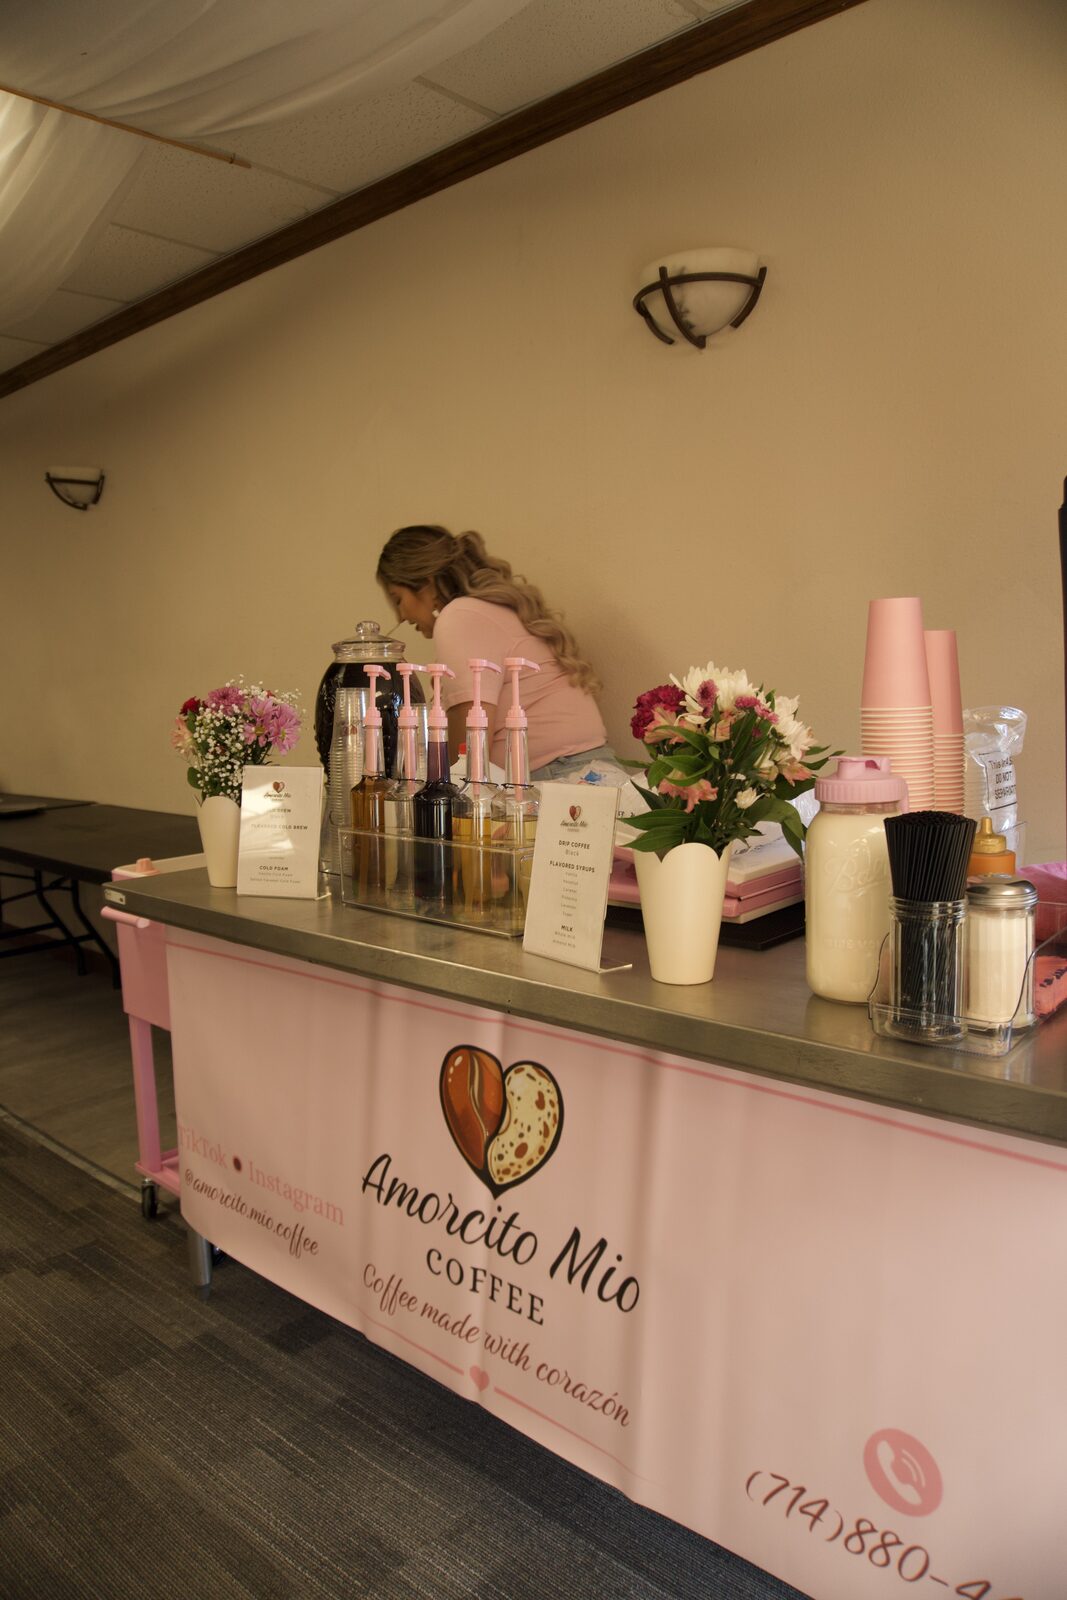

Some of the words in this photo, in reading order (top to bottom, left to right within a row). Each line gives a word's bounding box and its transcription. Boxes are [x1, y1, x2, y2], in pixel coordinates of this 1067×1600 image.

[549, 860, 575, 870] FLAVORED
[576, 864, 595, 873] SYRUPS
[571, 842, 591, 850] COFFEE
[560, 924, 574, 932] MILK
[178, 1125, 228, 1168] TikTok
[248, 1160, 345, 1226] Instagram
[185, 1168, 319, 1259] @amorcito.mio.coffee
[362, 1153, 538, 1265] Amorcito
[549, 1226, 640, 1312] Mio
[426, 1248, 544, 1326] COFFEE
[362, 1263, 418, 1317] Coffee
[420, 1313, 481, 1344] made
[484, 1331, 531, 1371] with
[536, 1363, 631, 1428] corazón
[745, 1470, 1024, 1600] (714)880-4
